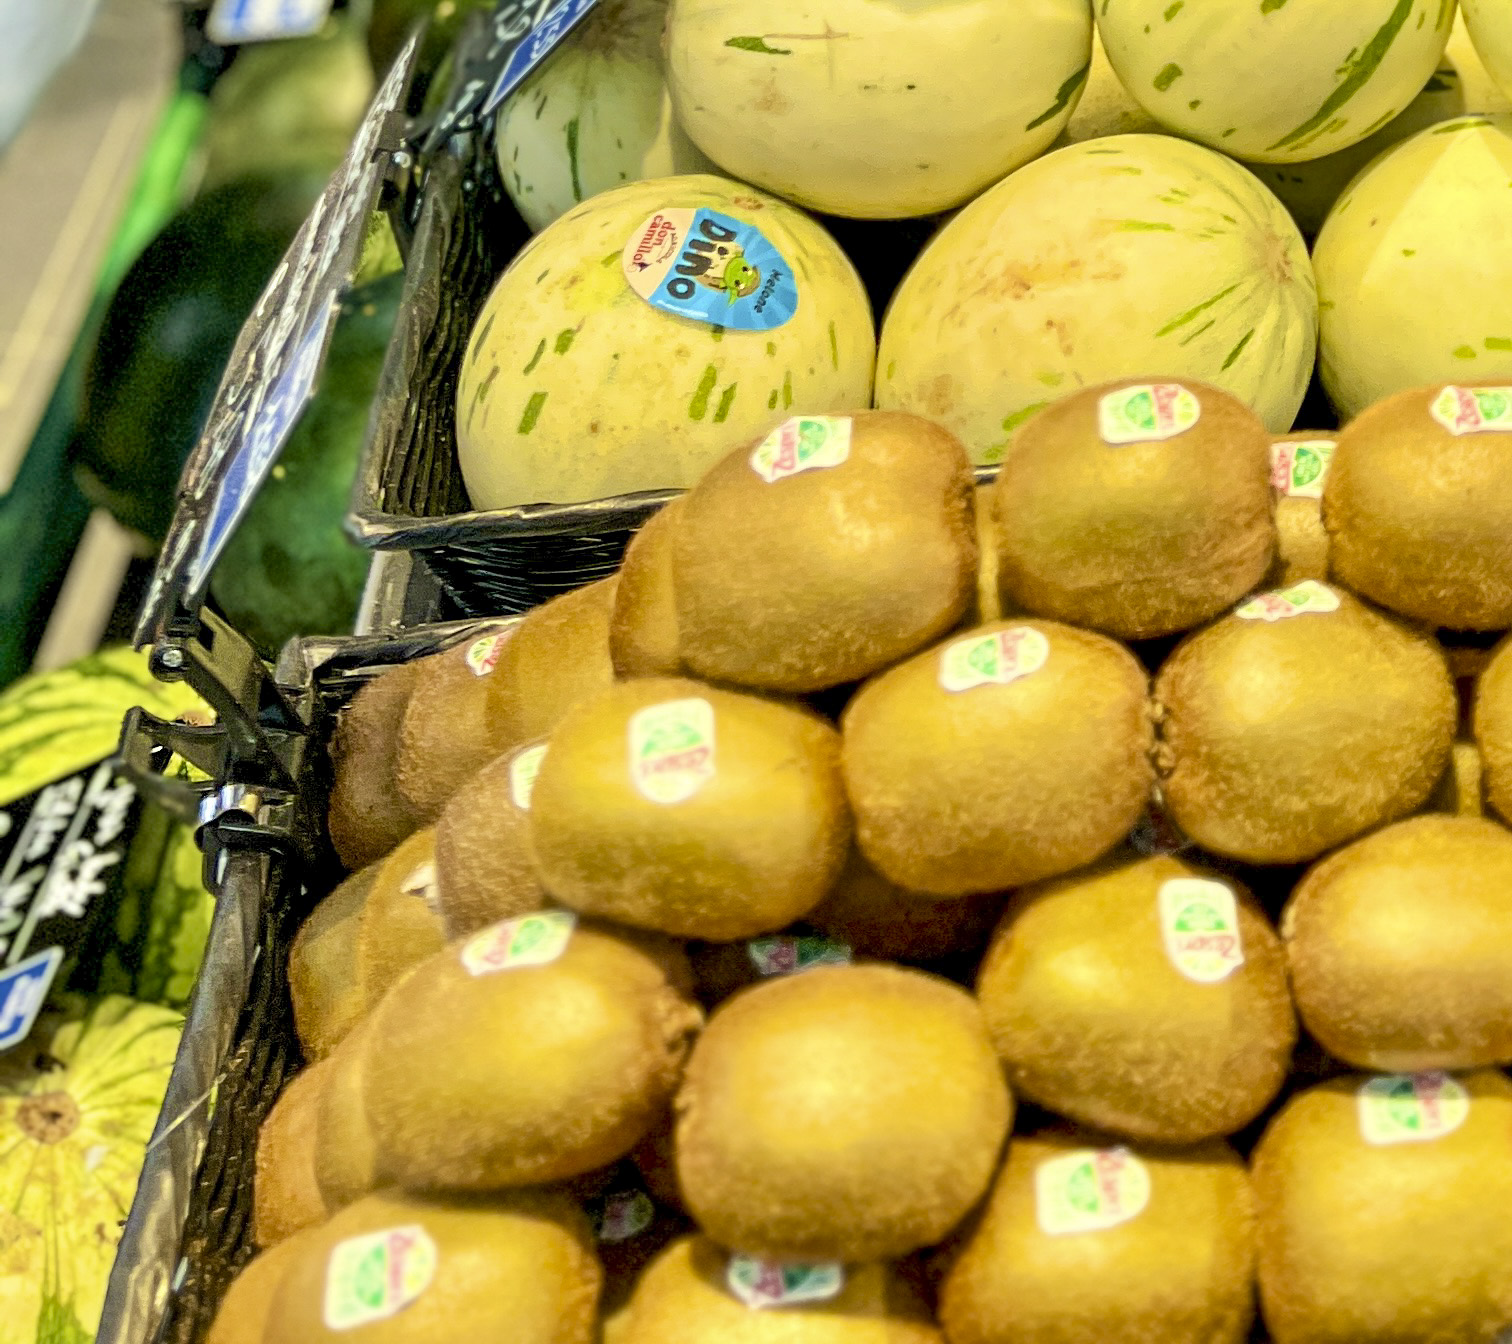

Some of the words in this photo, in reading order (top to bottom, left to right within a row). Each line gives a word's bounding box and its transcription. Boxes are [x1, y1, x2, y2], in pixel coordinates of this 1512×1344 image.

[633, 215, 663, 261] camillo
[652, 221, 676, 246] don
[754, 269, 783, 313] Melone
